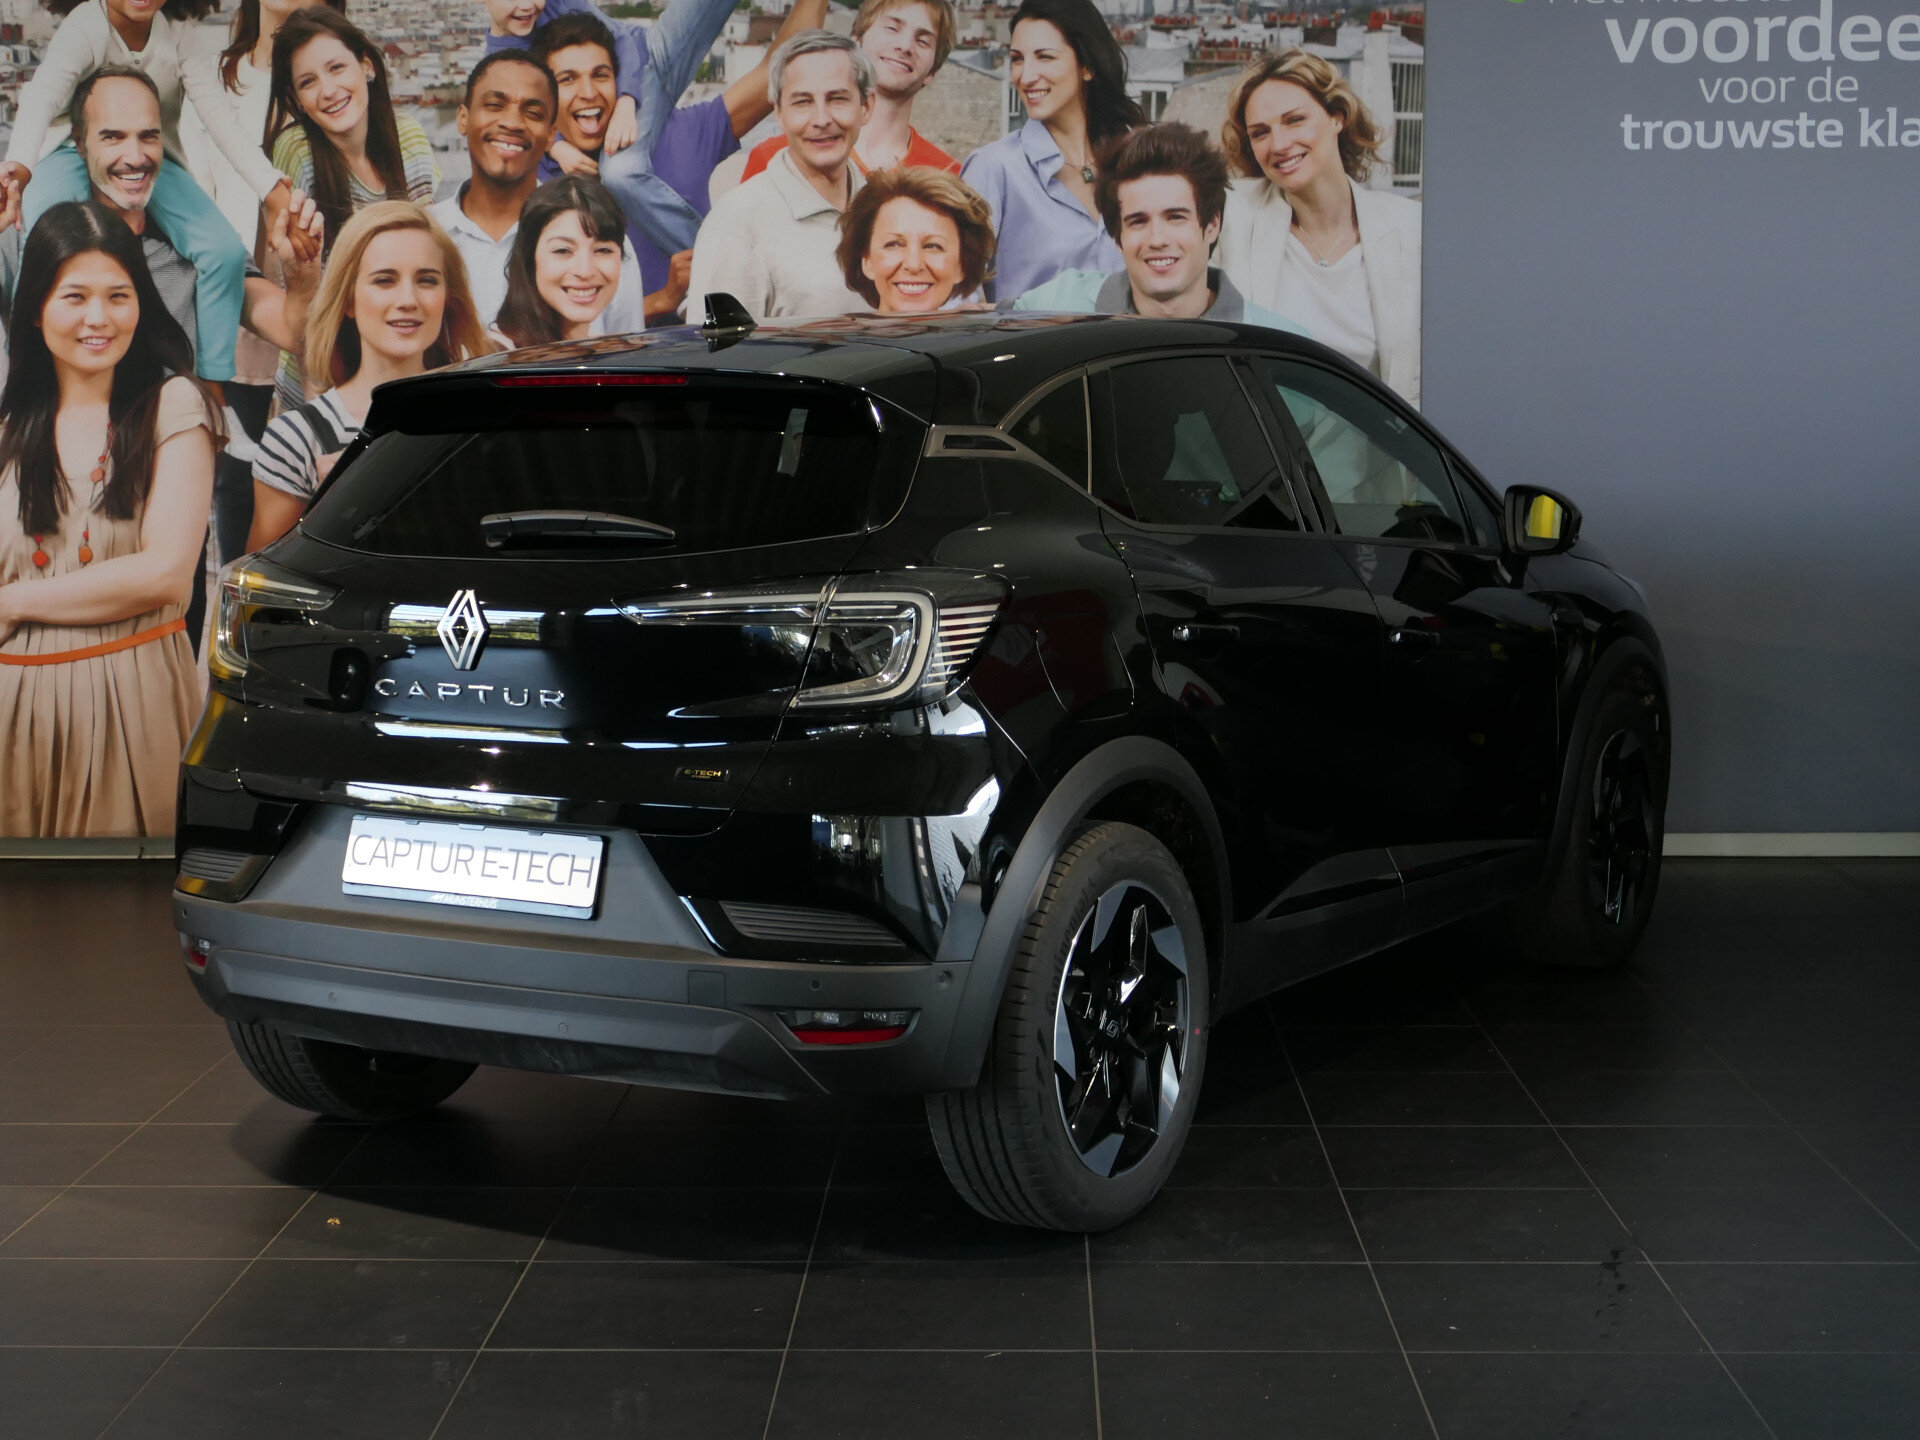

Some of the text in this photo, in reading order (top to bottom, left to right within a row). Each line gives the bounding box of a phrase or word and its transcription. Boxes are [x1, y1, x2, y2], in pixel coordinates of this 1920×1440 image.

[1698, 66, 1860, 104] voor de
[1620, 111, 1844, 151] trouwste
[374, 678, 567, 710] CAPTUR
[352, 834, 595, 888] CAPTUR E-TECH
